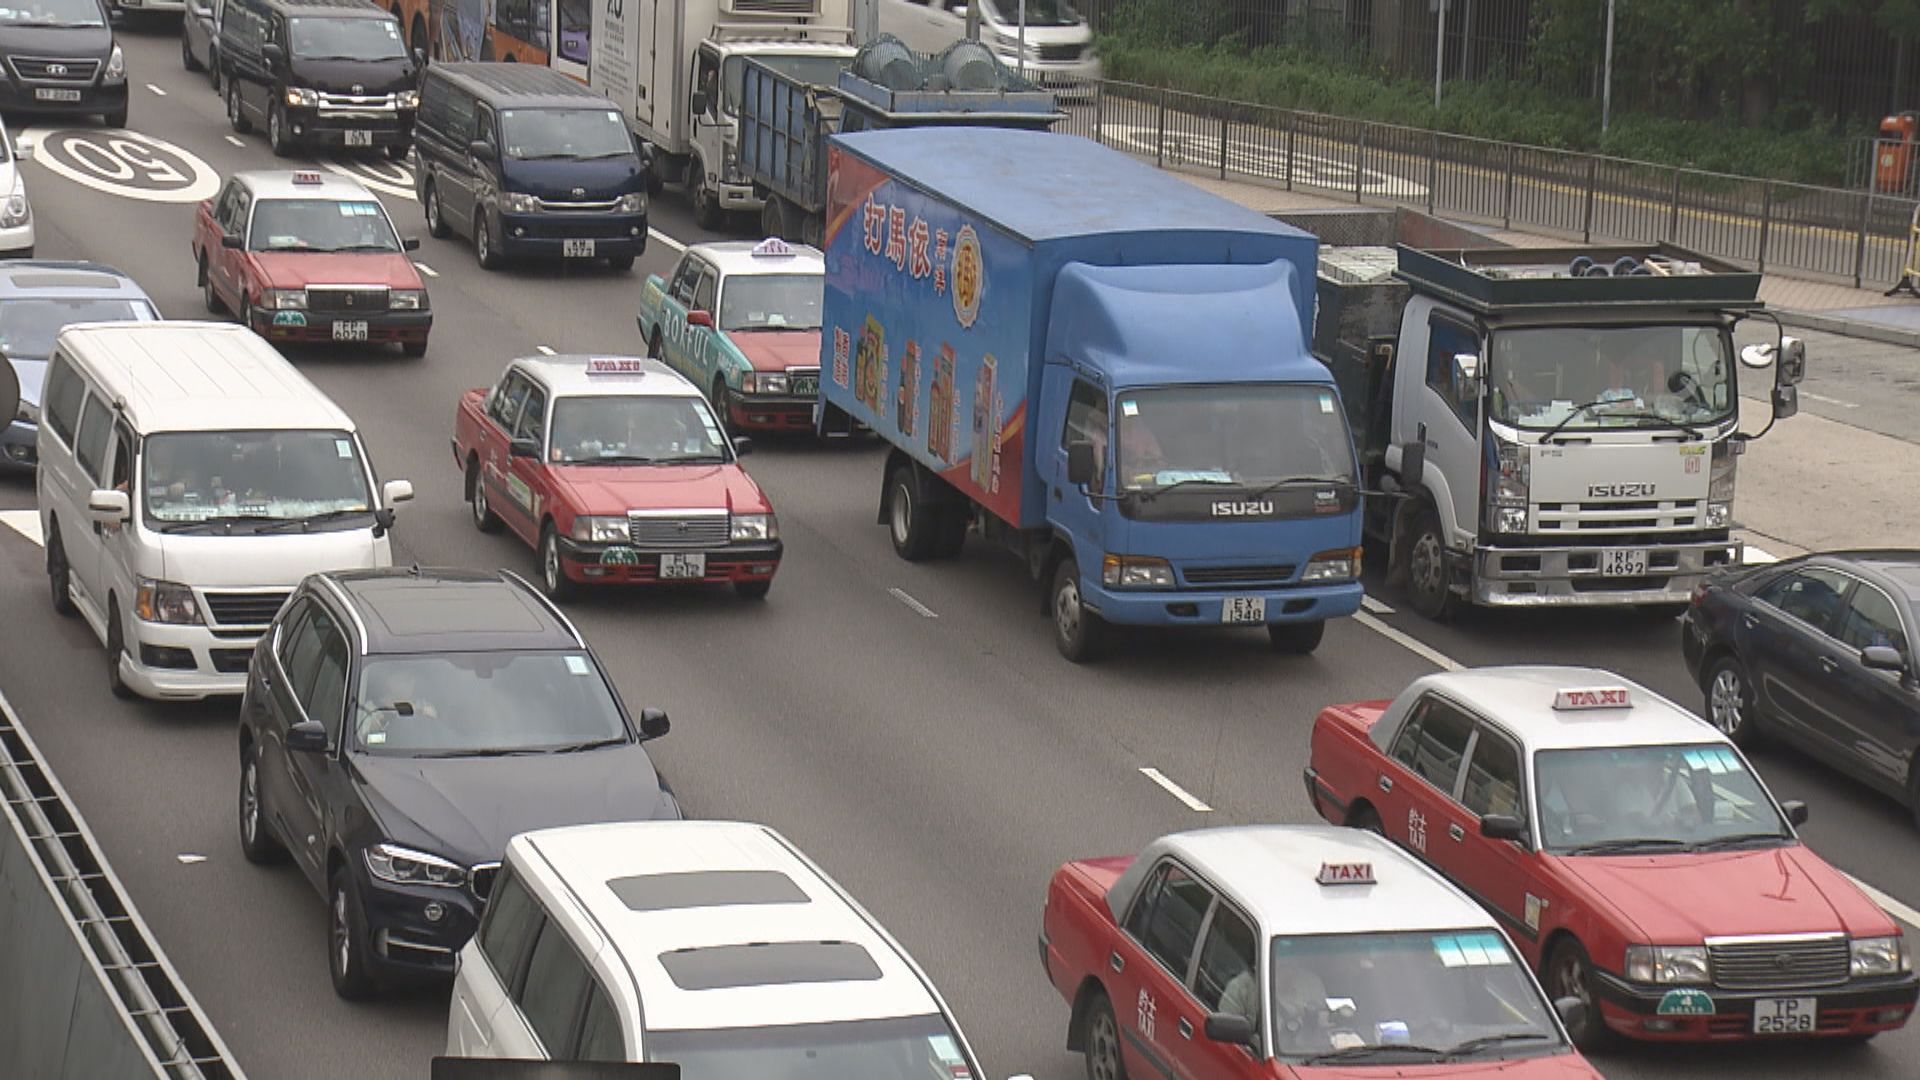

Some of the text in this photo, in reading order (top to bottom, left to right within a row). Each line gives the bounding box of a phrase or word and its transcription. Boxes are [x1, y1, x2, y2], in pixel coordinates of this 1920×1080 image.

[663, 307, 709, 368] BOXFUL
[593, 360, 640, 371] TAXI
[1588, 482, 1656, 498] ISUZU
[1212, 501, 1273, 515] ISUZU
[1604, 562, 1644, 574] 4692
[1567, 690, 1627, 705] TAXI
[1329, 864, 1370, 880] TAXI
[1759, 1015, 1811, 1032] 2528
